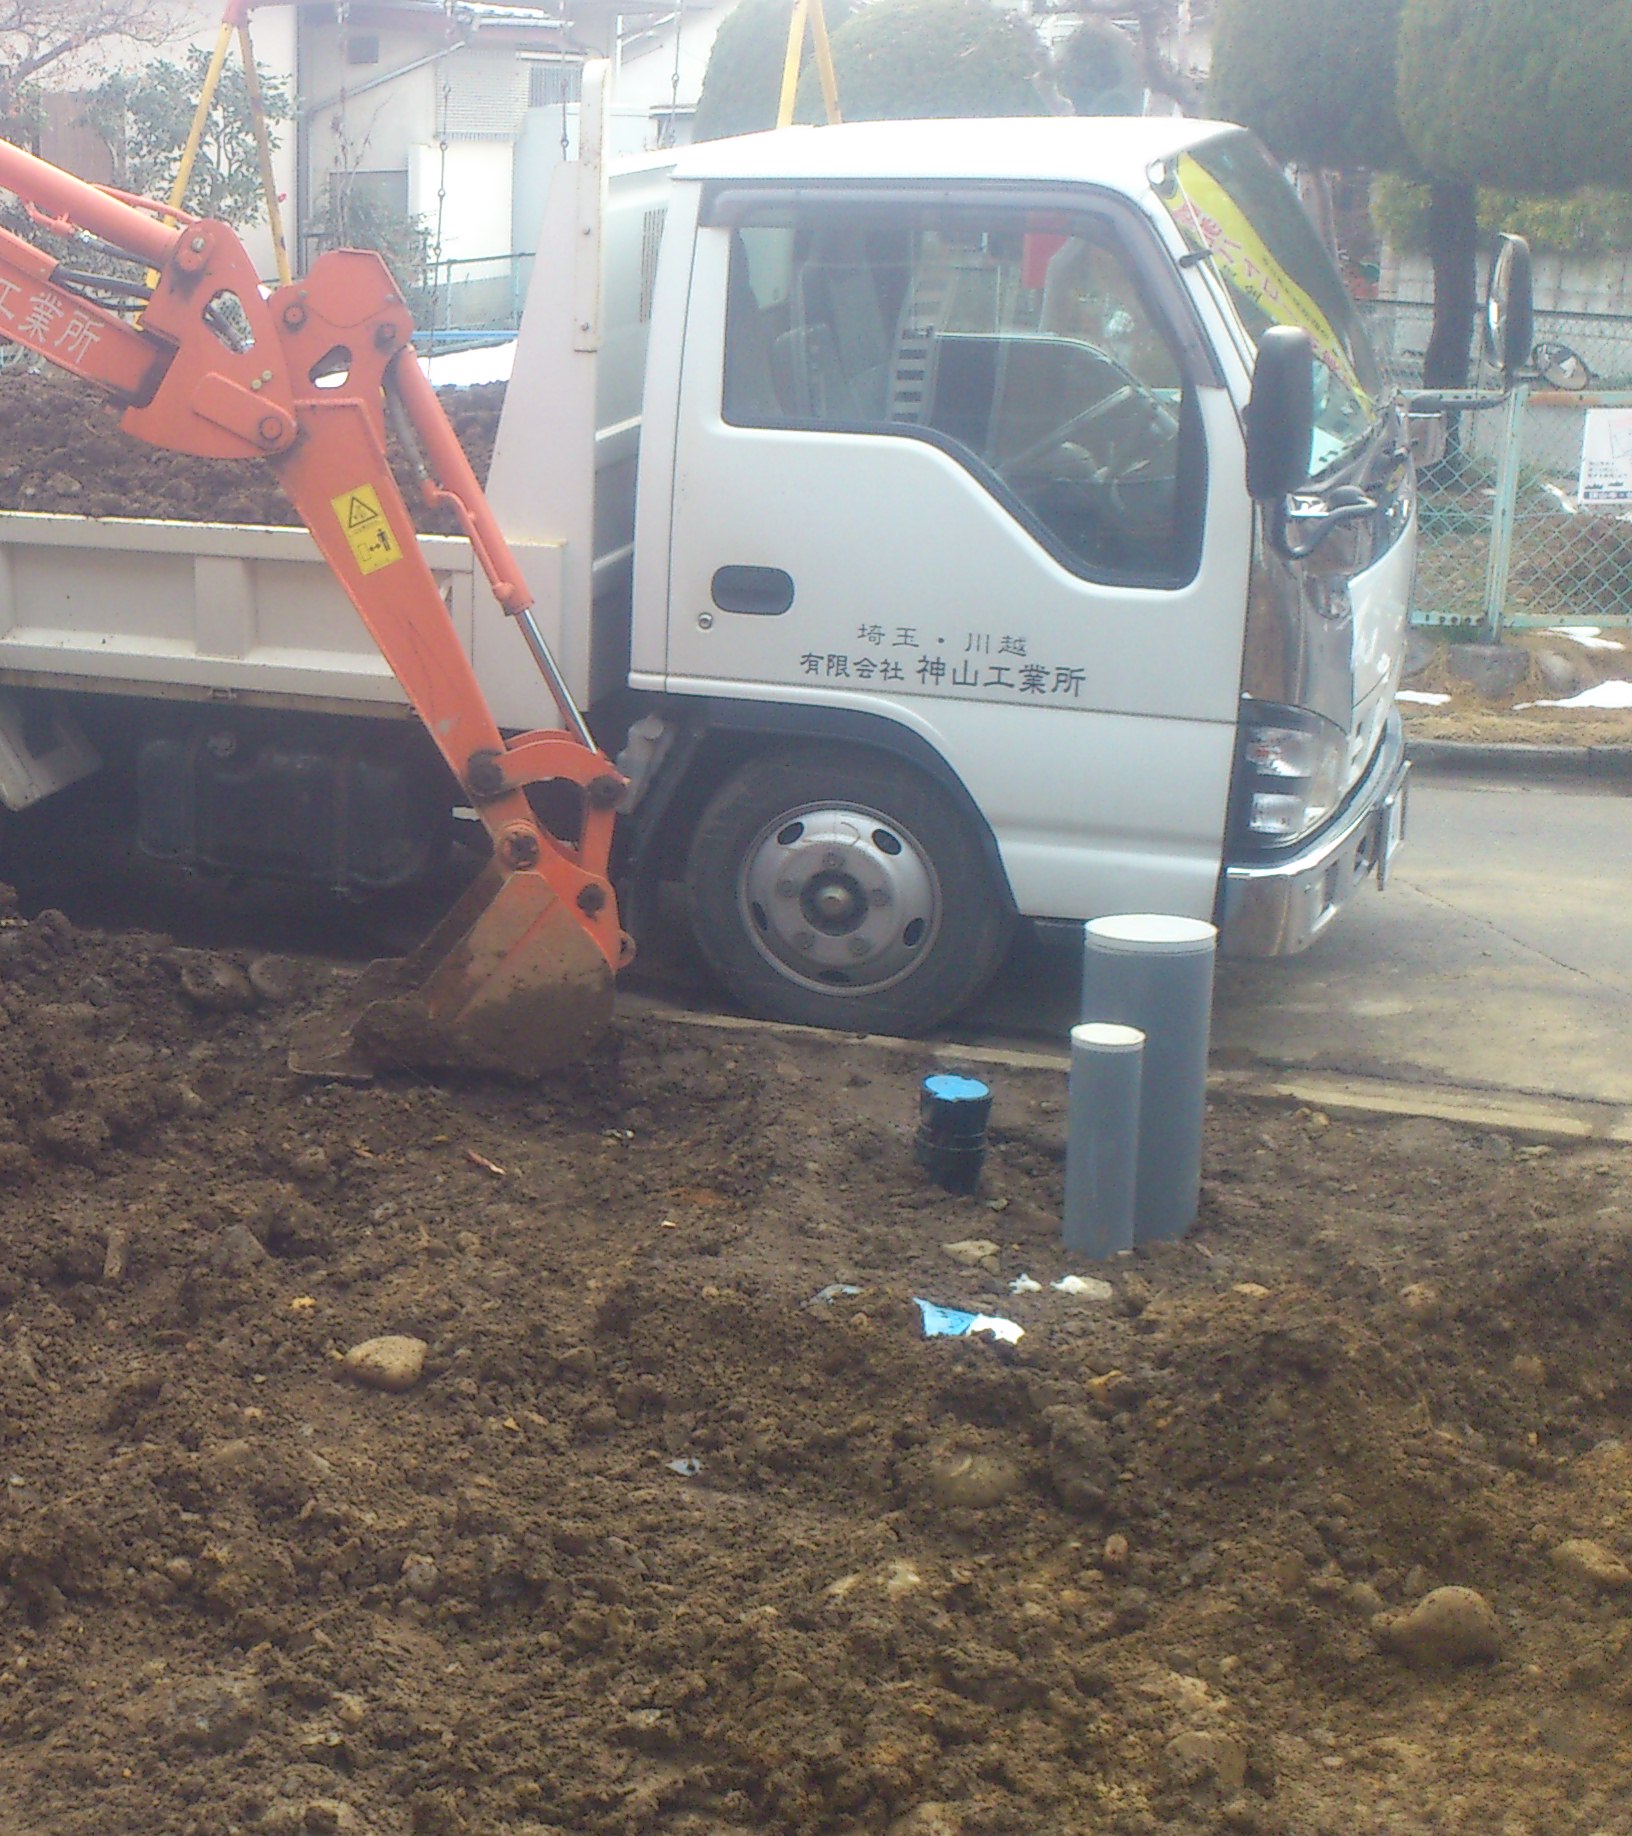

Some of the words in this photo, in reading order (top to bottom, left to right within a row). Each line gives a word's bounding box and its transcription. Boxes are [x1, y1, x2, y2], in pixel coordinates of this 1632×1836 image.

[799, 652, 905, 681] 有限会社
[915, 654, 1087, 698] 神山工業所
